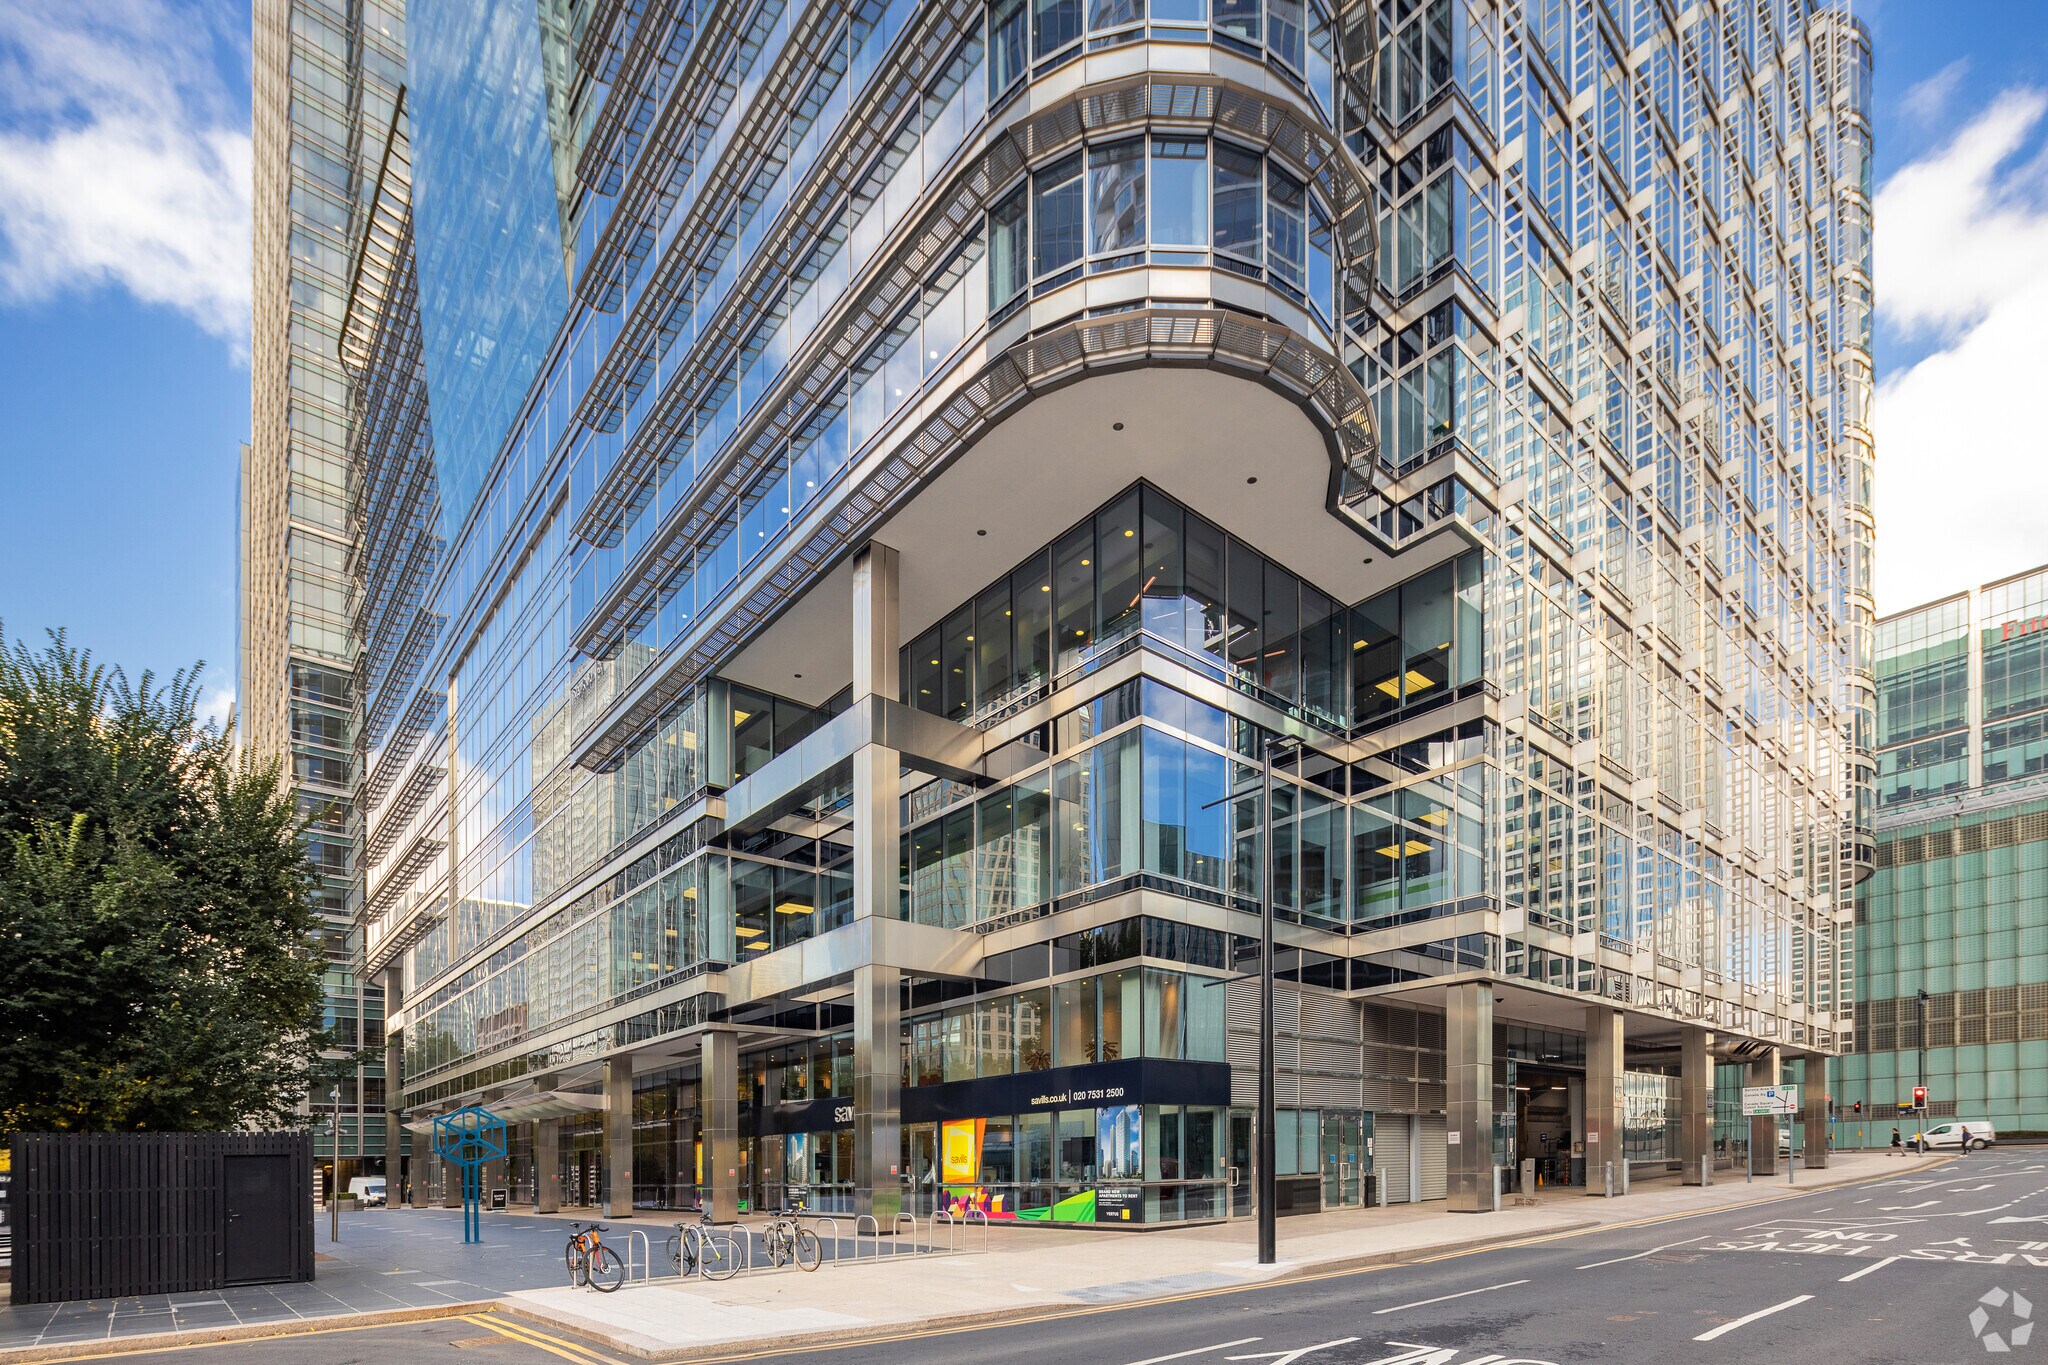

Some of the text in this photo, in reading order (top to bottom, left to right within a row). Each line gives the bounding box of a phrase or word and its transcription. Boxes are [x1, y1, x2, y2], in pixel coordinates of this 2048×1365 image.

[1031, 1087, 1124, 1105] savills.co.uk 020 7531 2500
[834, 1106, 855, 1123] sav
[951, 1154, 967, 1163] savills
